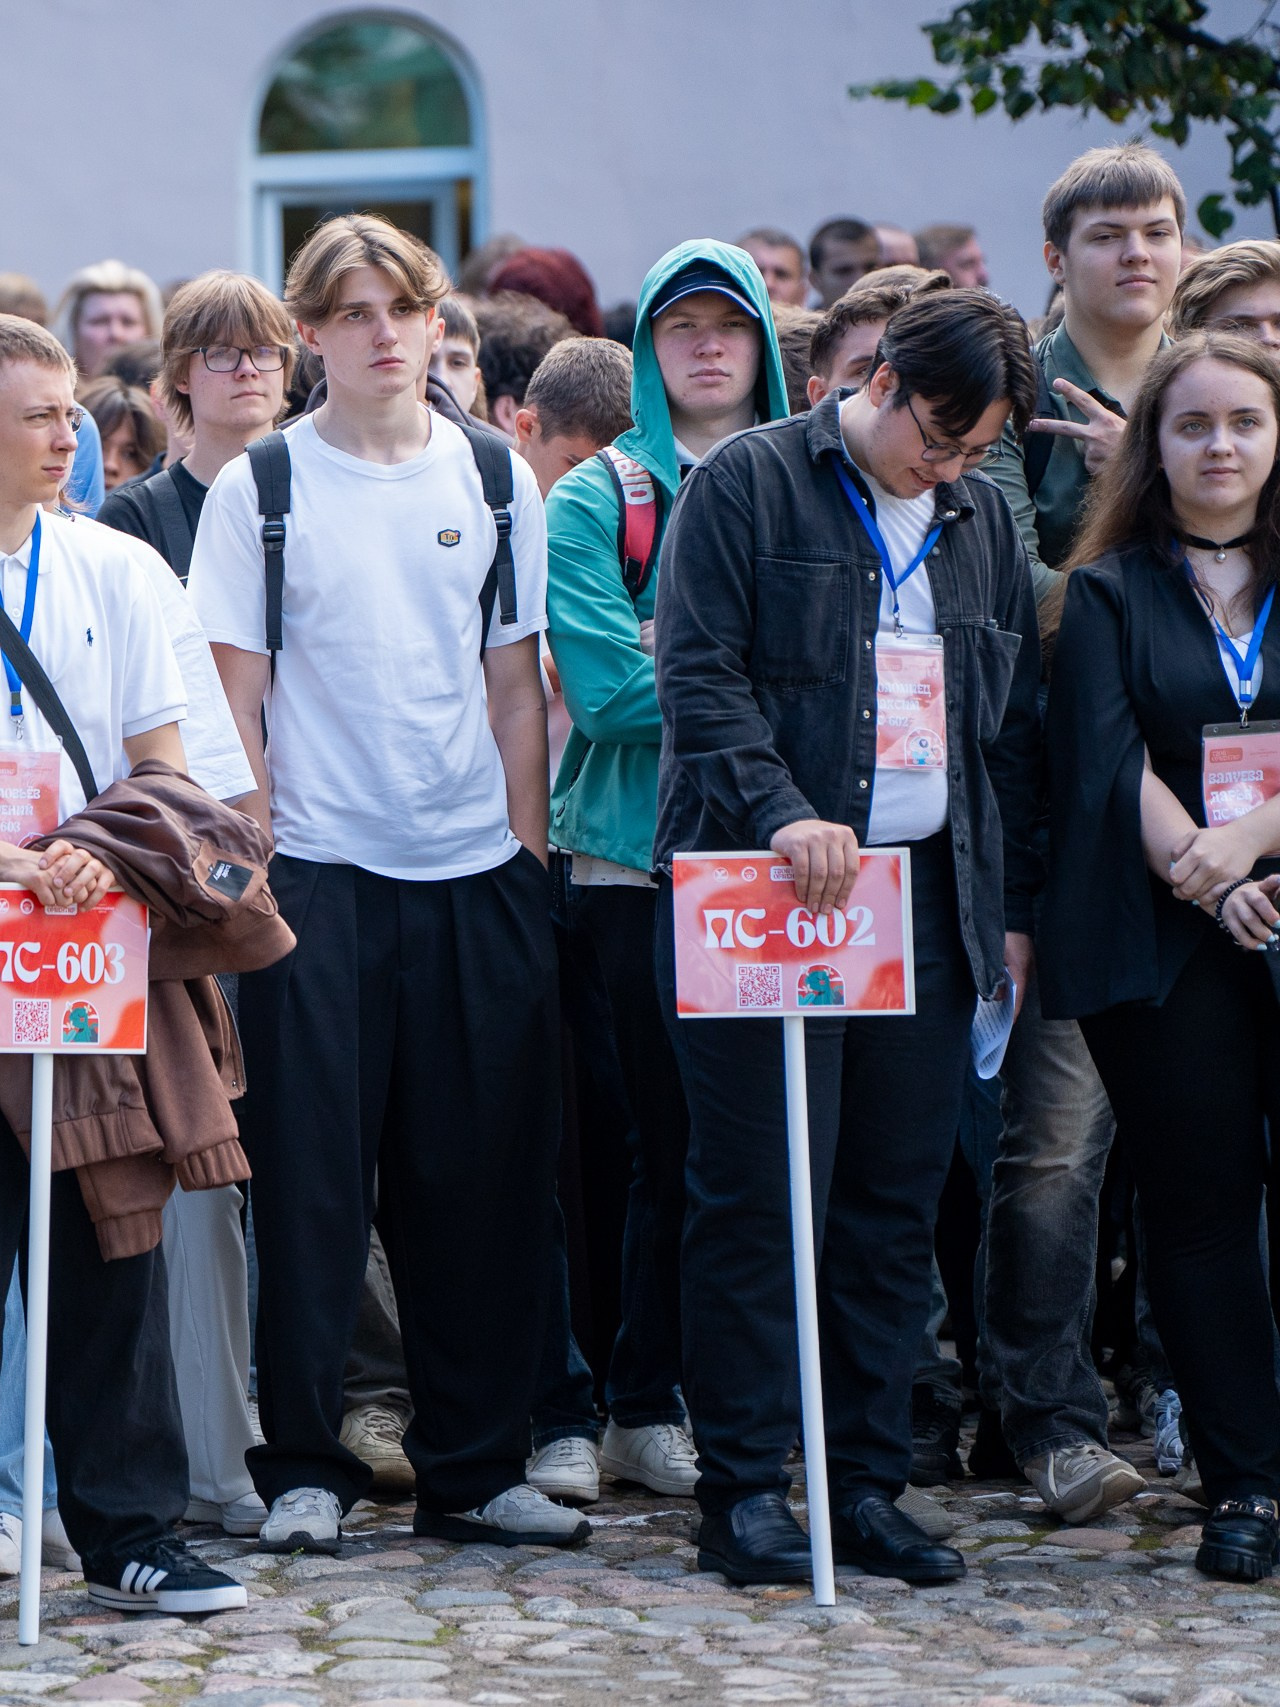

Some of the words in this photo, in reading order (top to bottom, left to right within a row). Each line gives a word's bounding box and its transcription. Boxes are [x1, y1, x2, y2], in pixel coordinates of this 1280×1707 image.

[878, 699, 920, 711] АКСИМ
[1208, 769, 1264, 784] ВАЛУЕВА
[703, 906, 876, 949] ПС-602
